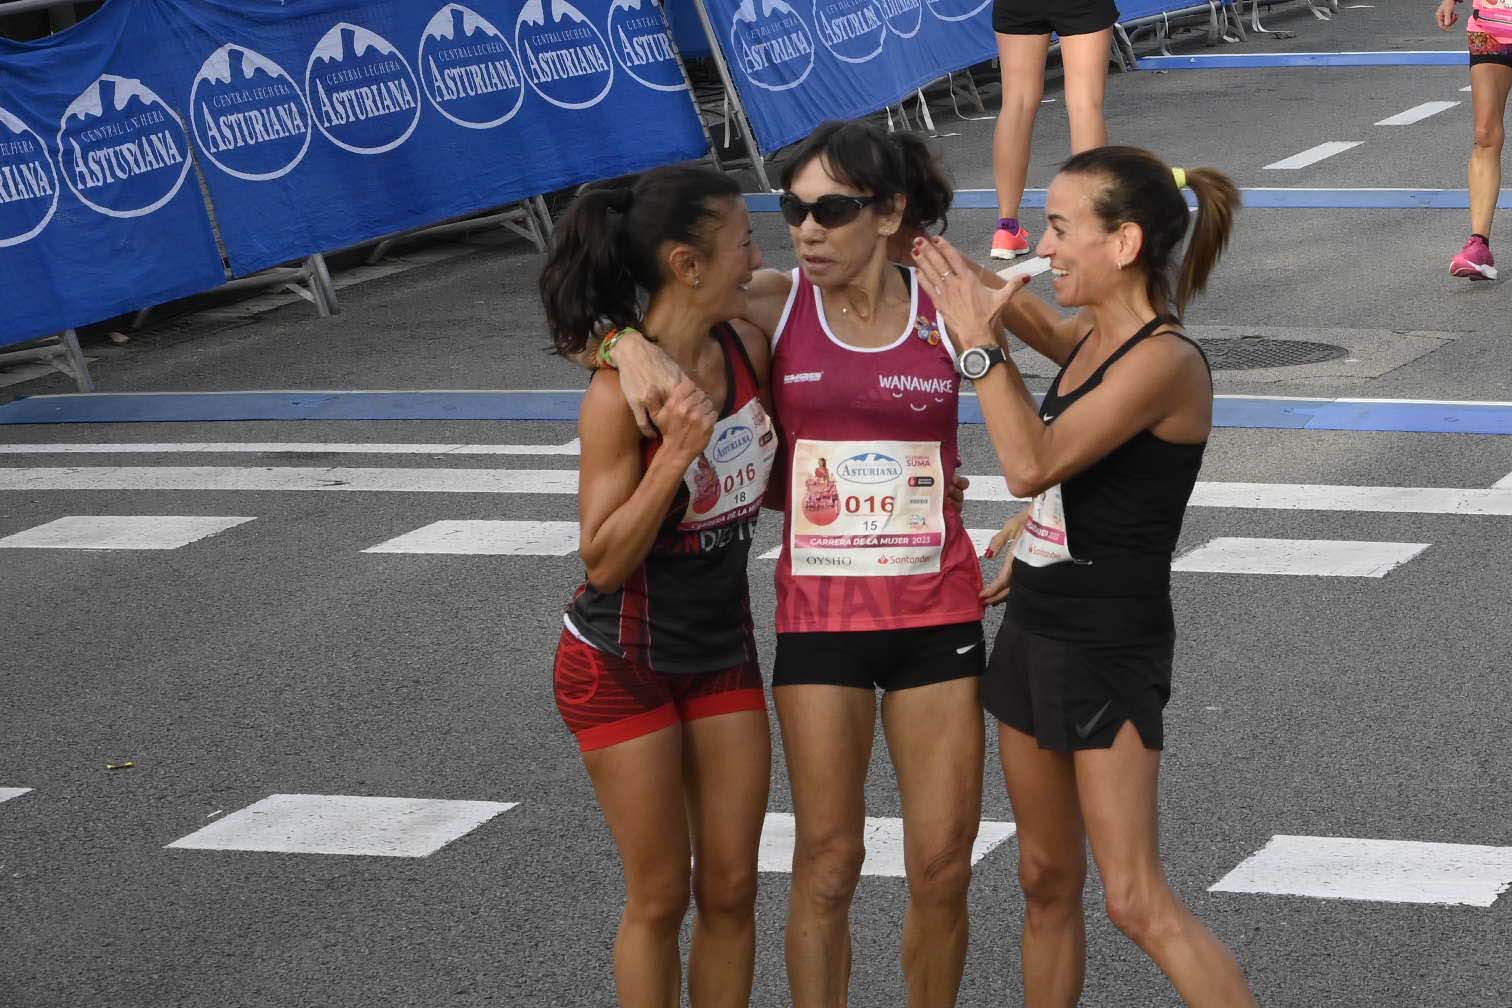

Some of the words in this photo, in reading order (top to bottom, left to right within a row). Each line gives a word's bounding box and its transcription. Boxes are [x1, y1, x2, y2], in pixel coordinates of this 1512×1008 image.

[524, 39, 609, 84] ASTURIANA
[428, 54, 520, 103] ASTURIANA
[316, 77, 417, 129] ASTURIANA
[201, 101, 306, 154] ASTURIANA
[878, 374, 953, 393] WANAWAKE
[842, 464, 898, 478] ASTURIANA
[905, 458, 931, 467] SUMA
[723, 461, 756, 493] 016
[733, 492, 746, 505] 18
[844, 495, 895, 514] 016
[862, 520, 878, 532] 15
[809, 536, 852, 547] CARRERA
[879, 536, 909, 545] MUJER
[805, 555, 852, 567] OYSHO
[889, 554, 932, 567] Santander
